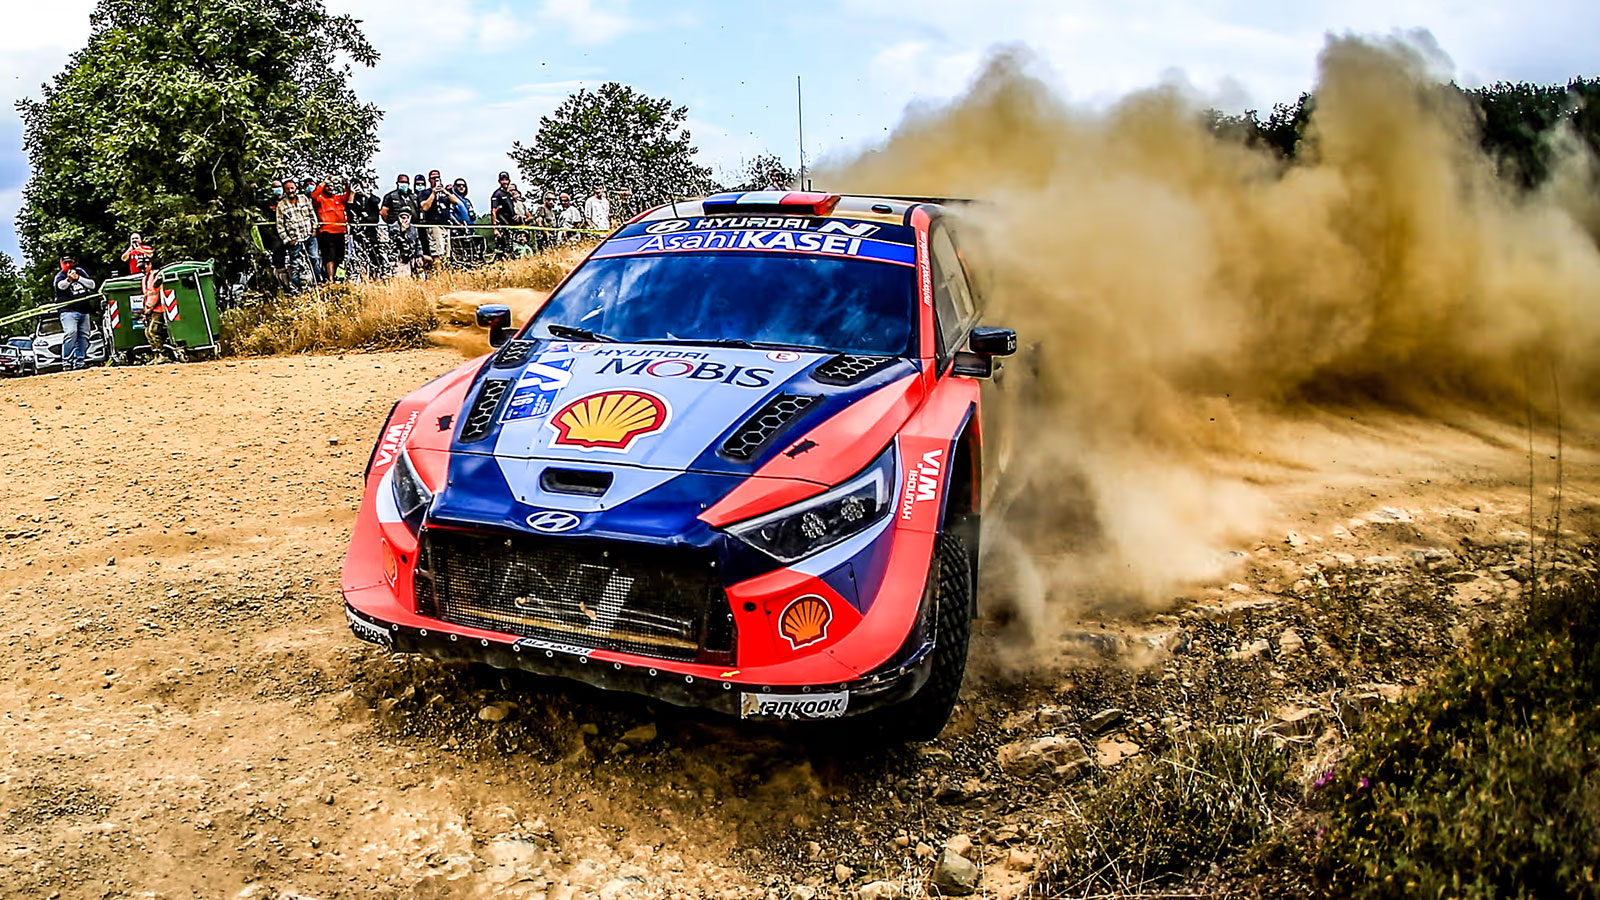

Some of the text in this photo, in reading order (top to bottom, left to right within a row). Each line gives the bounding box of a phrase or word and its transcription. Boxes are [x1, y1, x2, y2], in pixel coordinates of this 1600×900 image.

[694, 217, 811, 230] HYUNDAI
[593, 348, 710, 361] HYUNDAI
[594, 357, 775, 388] MOBIS
[902, 470, 919, 520] HYUNDAI
